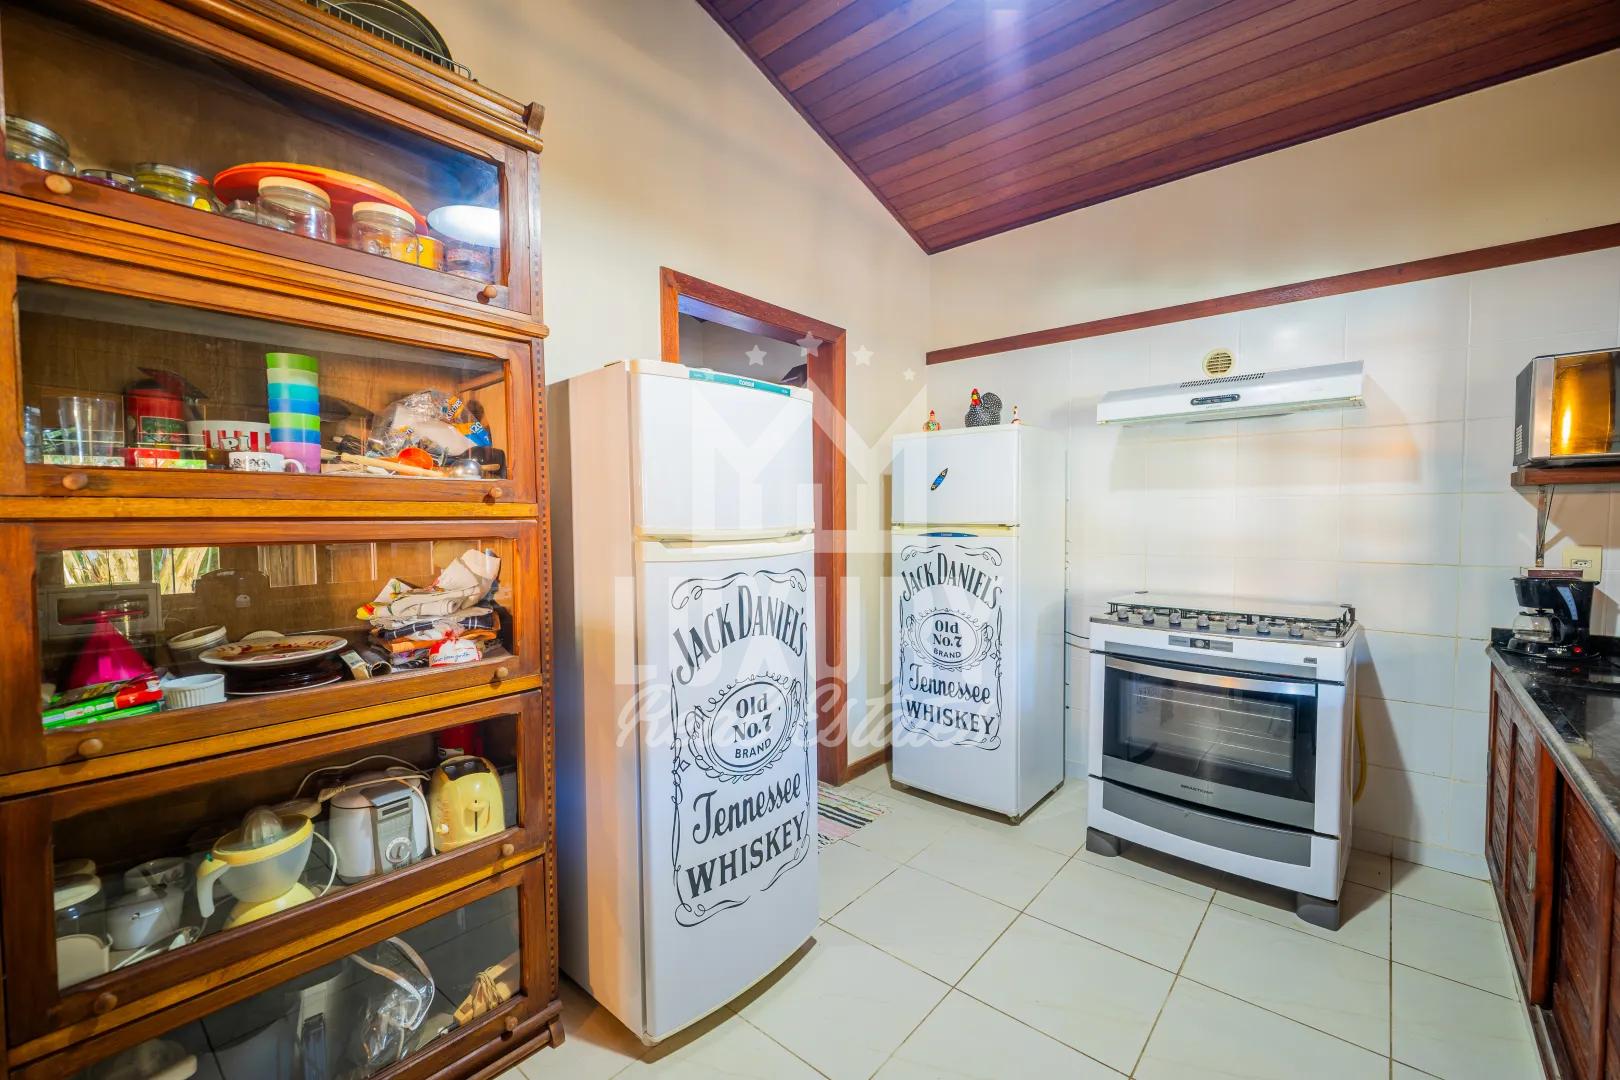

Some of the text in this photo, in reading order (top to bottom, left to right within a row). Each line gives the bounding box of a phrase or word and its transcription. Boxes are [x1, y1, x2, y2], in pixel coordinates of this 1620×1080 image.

[901, 552, 1003, 610] JACK DANIEL'S
[672, 585, 808, 685] JACK DANIEL'S
[935, 619, 959, 635] Old
[933, 647, 962, 659] BRAND
[909, 663, 991, 704] Tennessee
[735, 693, 769, 719] Old
[905, 698, 995, 735] WHISKEY
[734, 738, 772, 759] BRAND
[692, 772, 801, 845] Tennessee
[684, 810, 806, 899] WHISKEY
